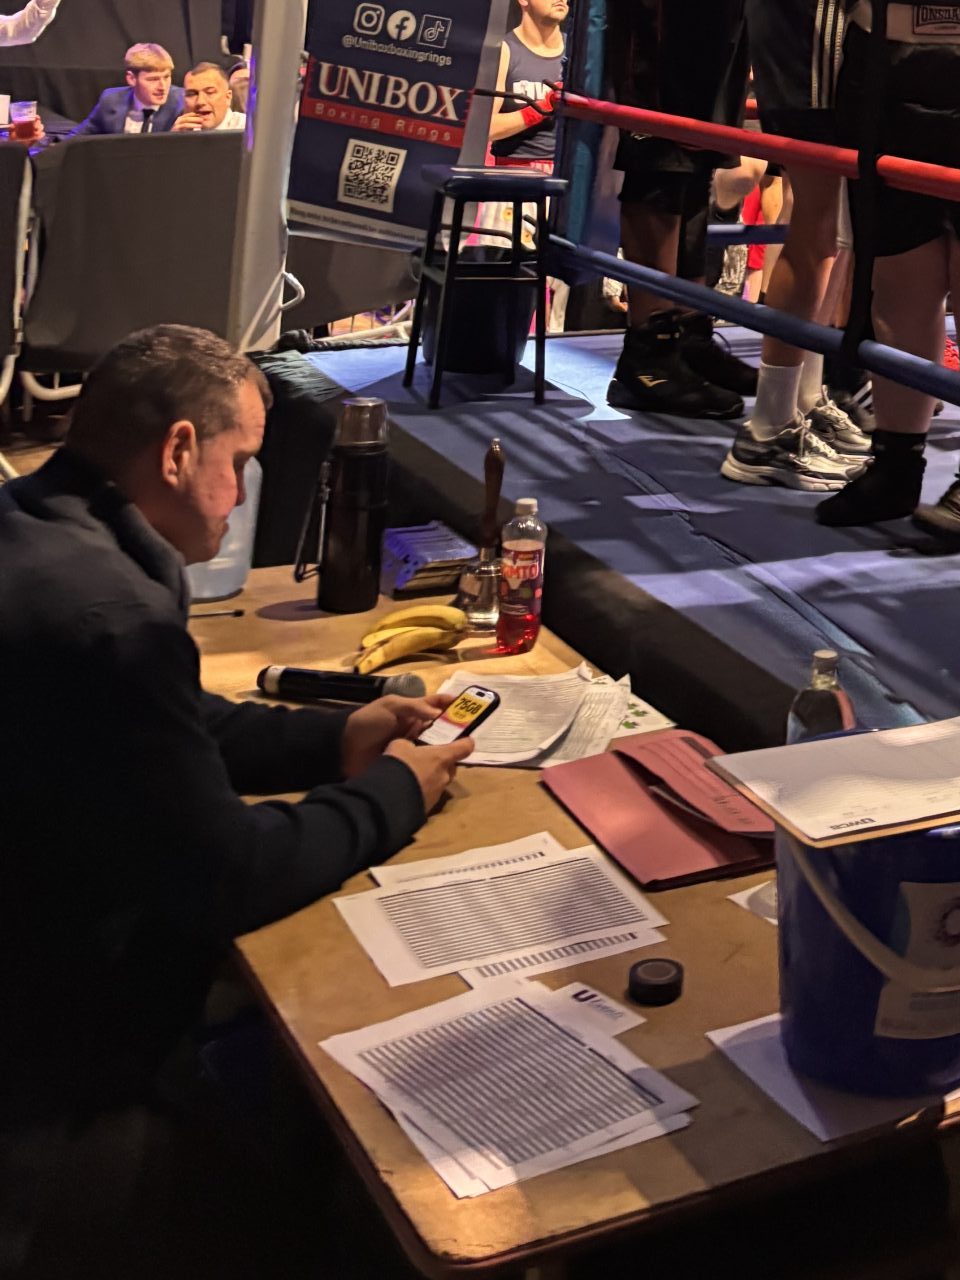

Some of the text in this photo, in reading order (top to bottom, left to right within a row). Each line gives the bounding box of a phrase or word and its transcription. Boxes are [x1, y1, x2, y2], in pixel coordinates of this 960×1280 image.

[317, 61, 465, 121] UNIBOX
[314, 103, 452, 142] Boxing Rings
